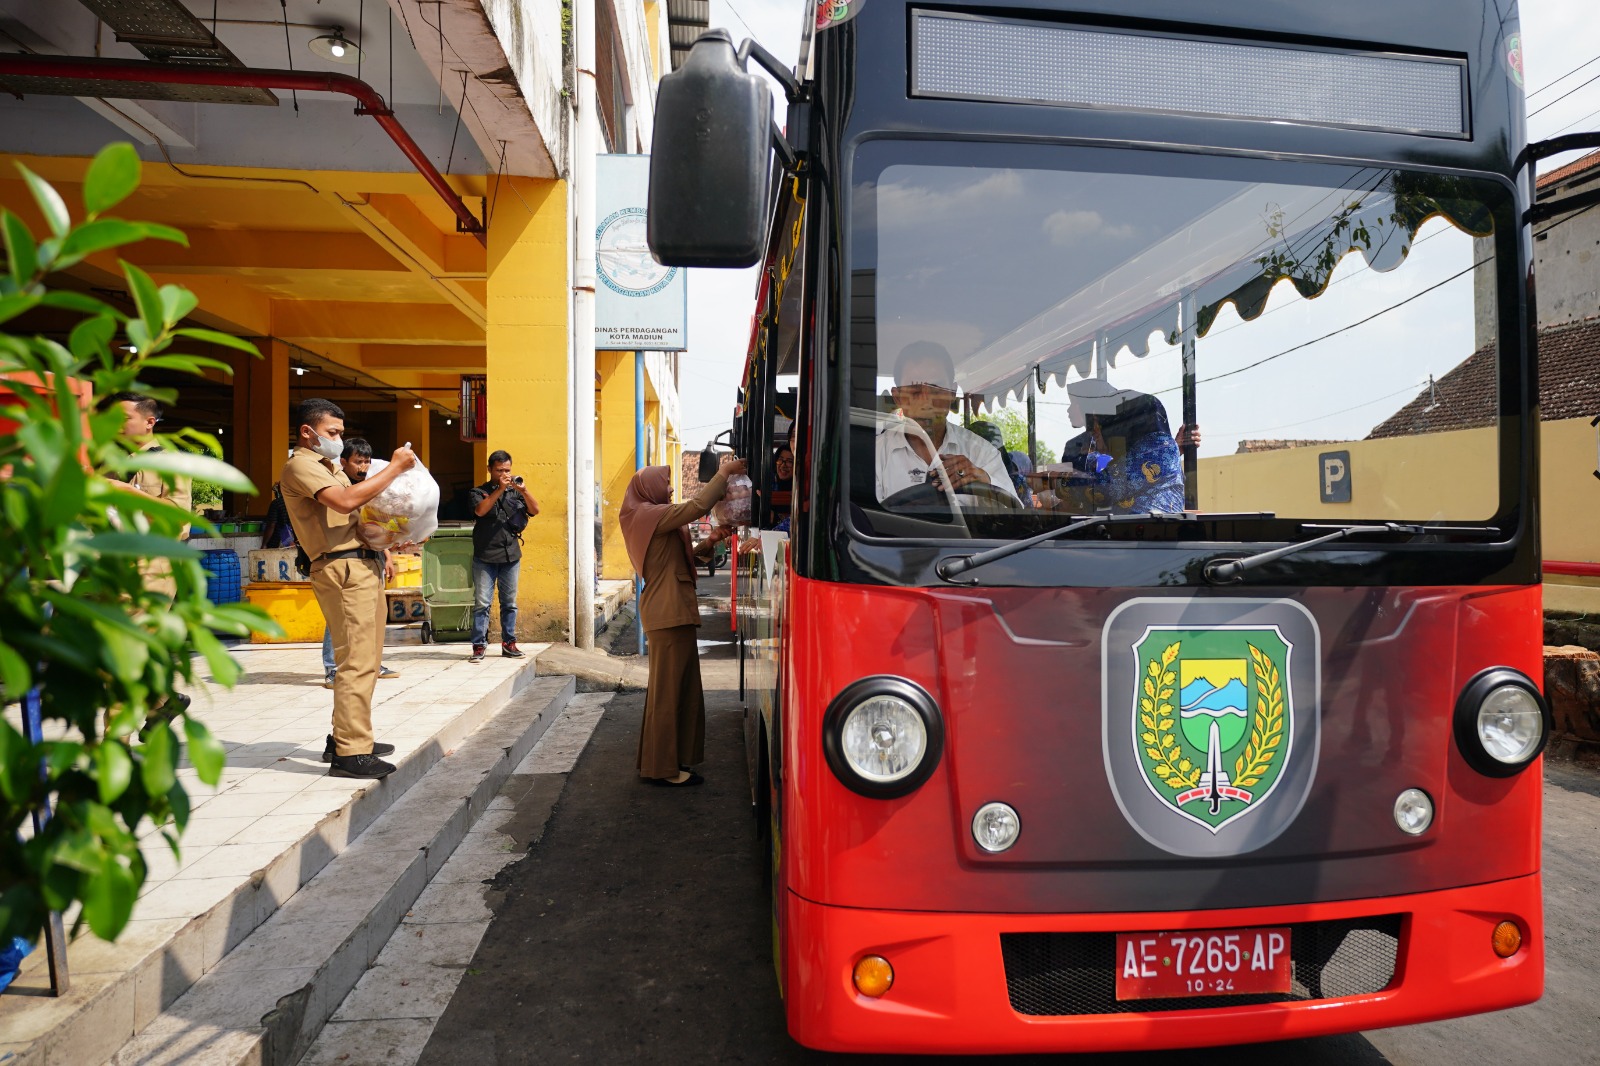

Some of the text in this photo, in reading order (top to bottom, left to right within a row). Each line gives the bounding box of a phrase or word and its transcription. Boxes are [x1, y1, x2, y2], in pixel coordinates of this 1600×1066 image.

[620, 207, 648, 216] KEMBA
[599, 273, 651, 298] PERDAGANGAN
[650, 280, 669, 295] KOTA
[1324, 458, 1345, 495] P
[1123, 933, 1285, 979] AE 7265 AP
